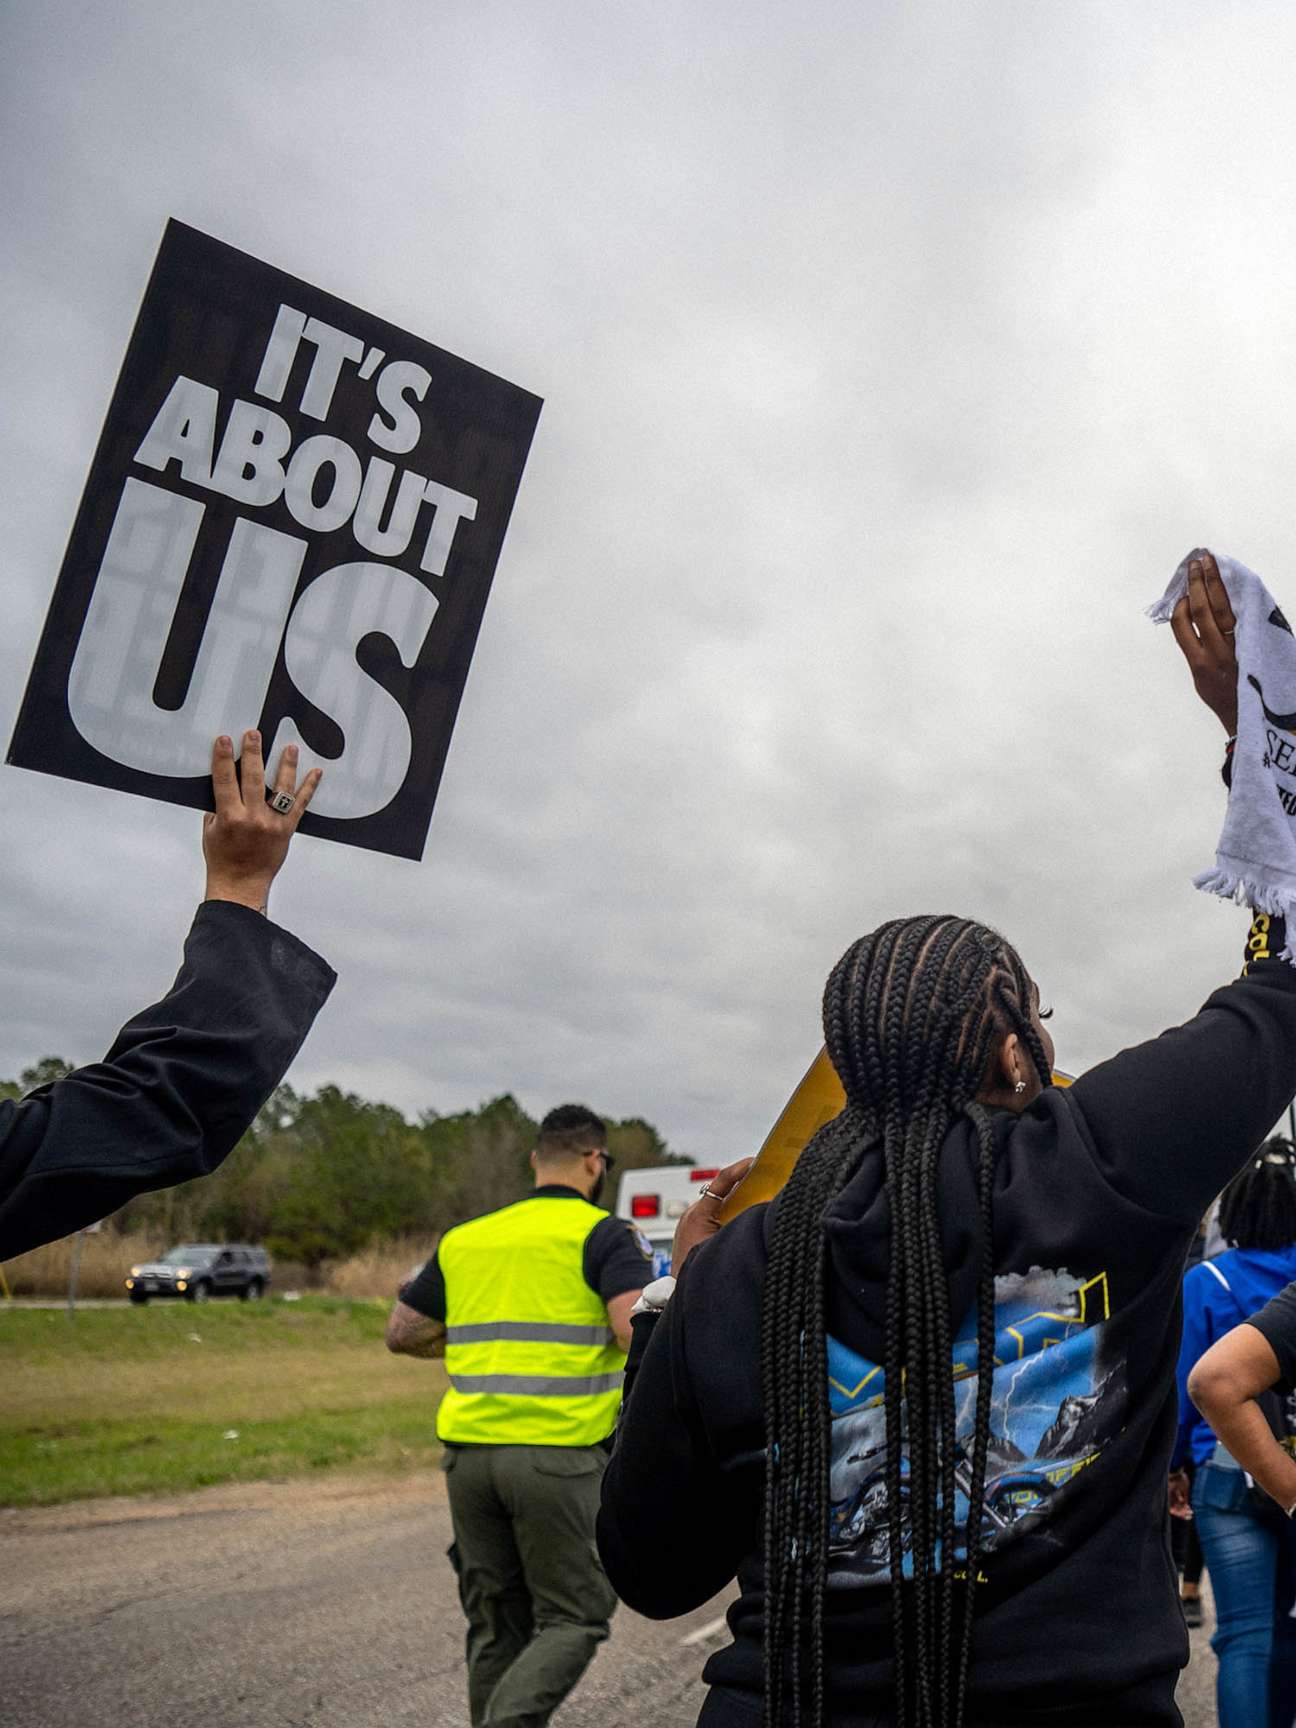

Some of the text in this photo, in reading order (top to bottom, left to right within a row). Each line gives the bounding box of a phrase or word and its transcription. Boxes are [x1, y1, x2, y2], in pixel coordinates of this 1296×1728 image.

[133, 375, 479, 578] ABOUT
[253, 303, 433, 454] IT'S
[67, 476, 441, 819] US
